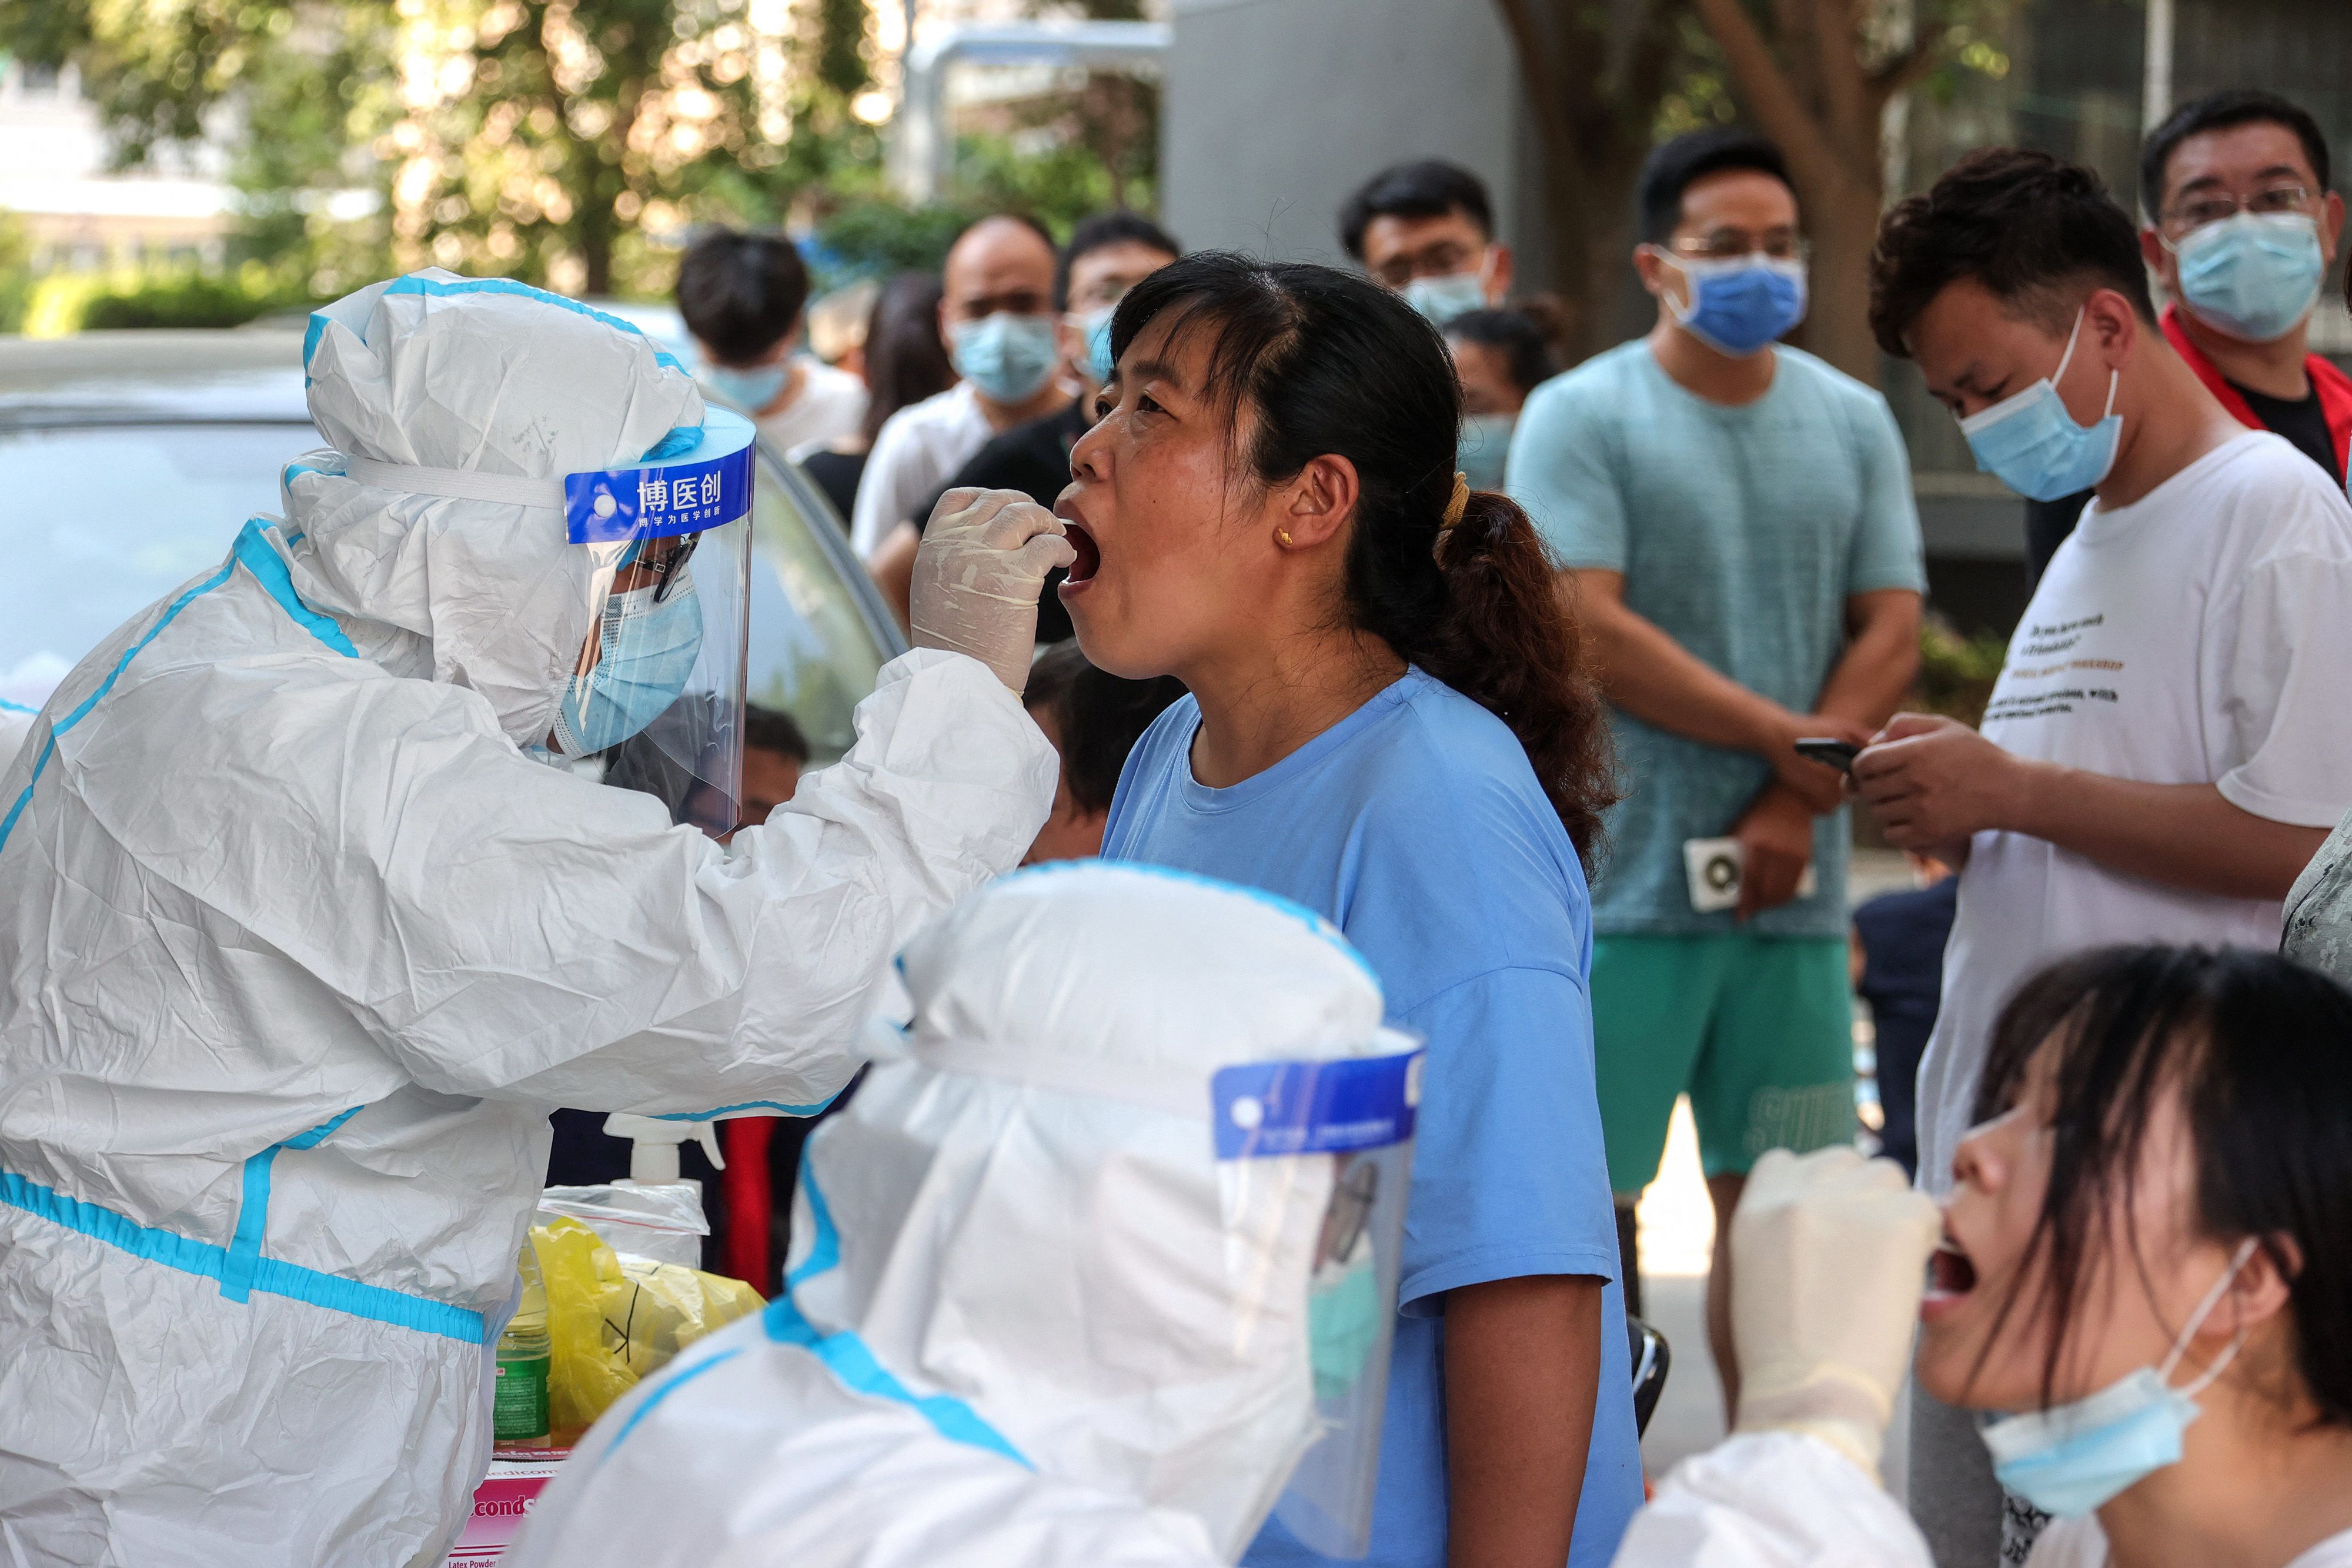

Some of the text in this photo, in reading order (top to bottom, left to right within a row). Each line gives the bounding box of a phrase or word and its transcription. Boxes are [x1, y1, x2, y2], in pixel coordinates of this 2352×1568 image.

[637, 470, 721, 514] 博医创
[639, 506, 720, 528] 博学为医学创新
[470, 1559, 496, 1568] Powder
